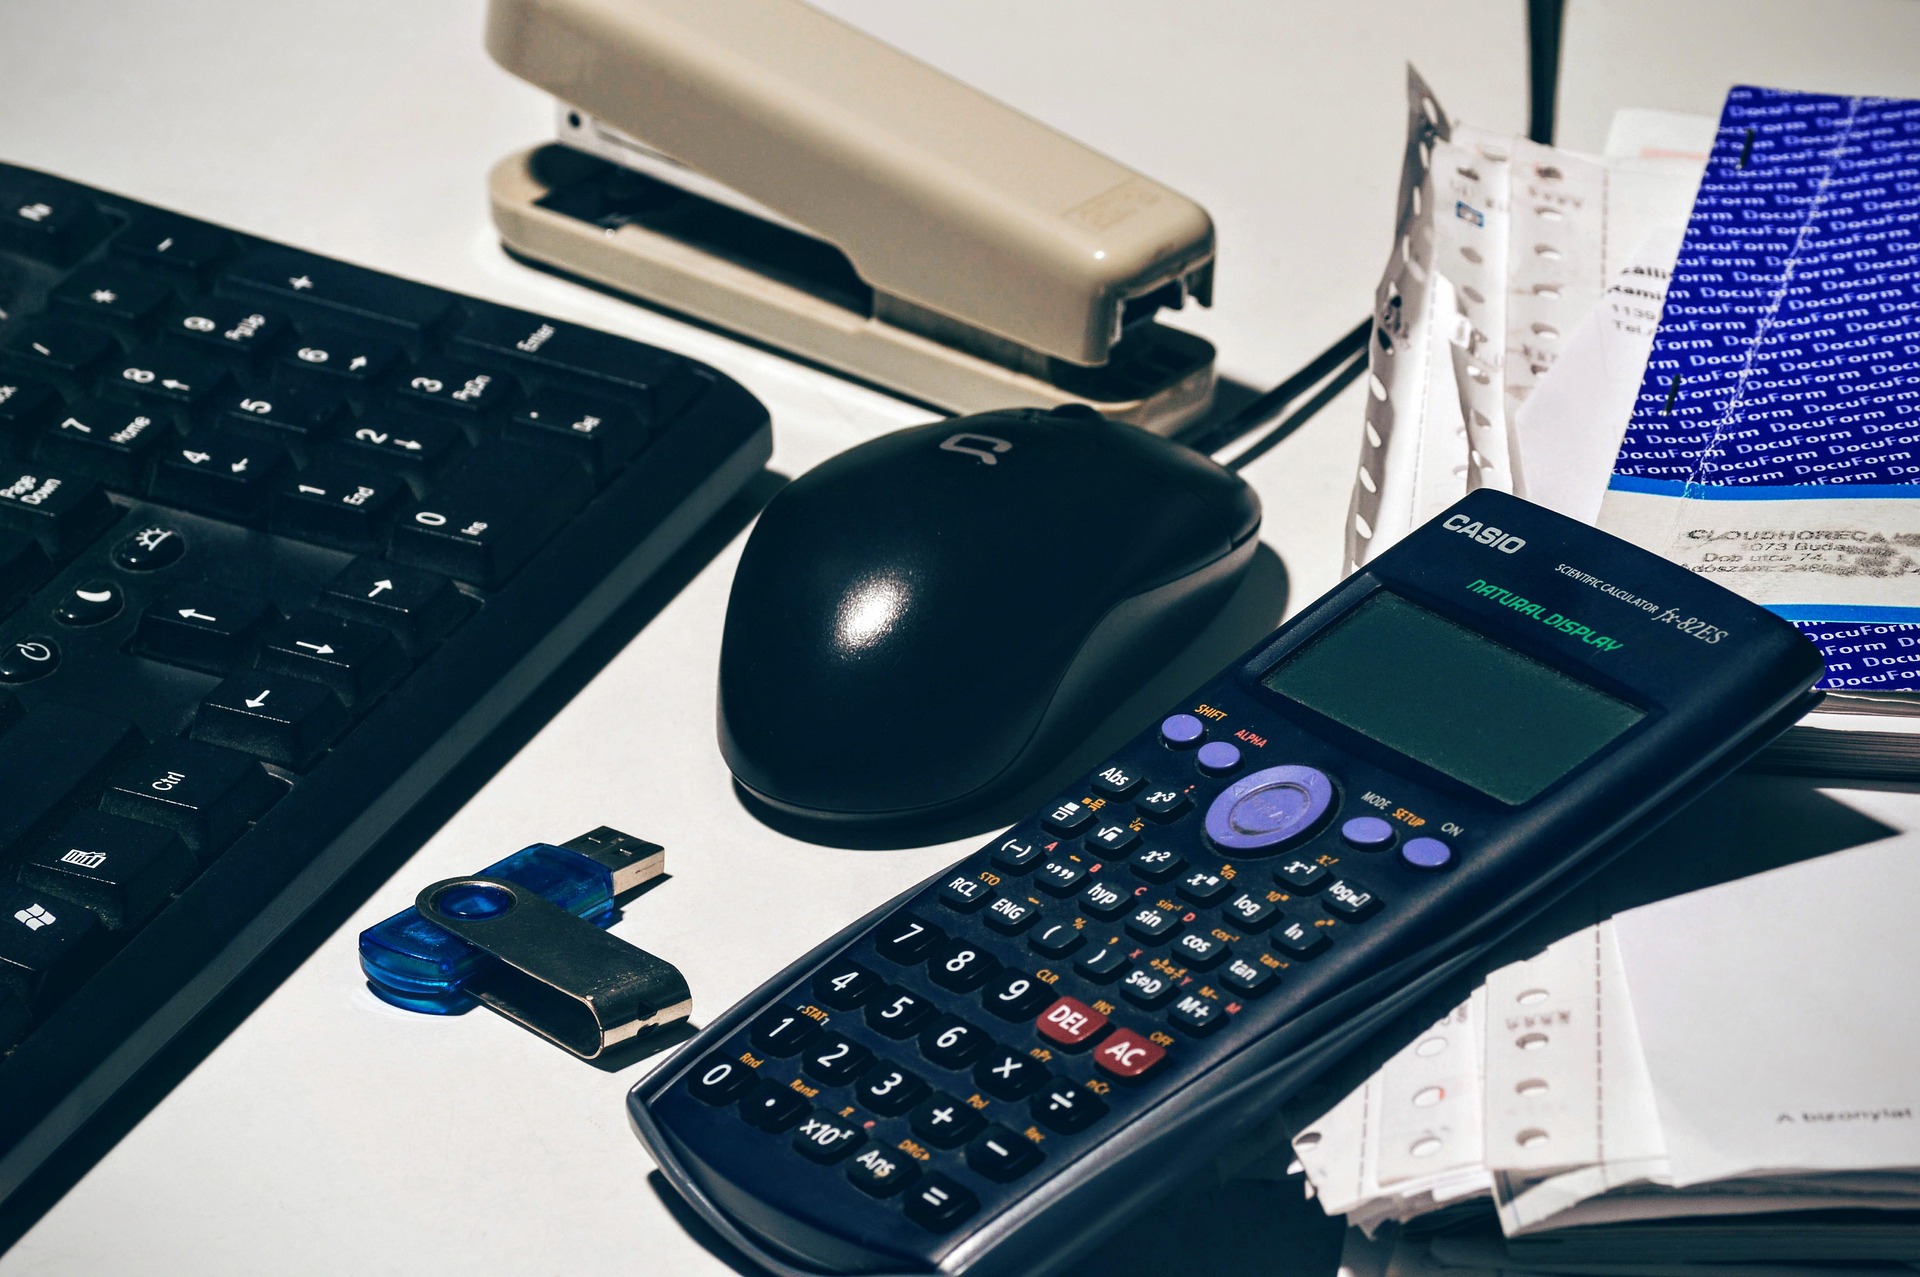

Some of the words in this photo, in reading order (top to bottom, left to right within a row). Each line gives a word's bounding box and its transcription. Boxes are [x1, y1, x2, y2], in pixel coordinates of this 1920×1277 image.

[1742, 206, 1854, 221] DocuForm
[1710, 224, 1821, 236] DocuForm
[1799, 229, 1911, 250] DocuForm
[1765, 248, 1878, 267] DocuForm
[1733, 267, 1845, 284] DocuForm
[1667, 302, 1779, 316] DocuForm
[1788, 288, 1903, 311] DocuForm
[1700, 286, 1812, 299] DocuForm
[1756, 308, 1870, 331] DocuForm
[1723, 328, 1836, 346] DocuForm
[298, 347, 329, 363] 6
[1690, 348, 1802, 366] DocuForm
[1779, 350, 1895, 372] DocuForm
[123, 367, 155, 383] 8
[411, 377, 443, 392] 3
[1745, 370, 1860, 391] DocuForm
[240, 398, 272, 414] 5
[1679, 409, 1794, 430] DocuForm
[1803, 390, 1920, 414] DocuForm
[1713, 390, 1827, 411] DocuForm
[61, 416, 92, 433] 7
[1646, 428, 1760, 445] DocuForm
[1769, 410, 1886, 433] DocuForm
[355, 428, 388, 444] 2
[1736, 431, 1852, 454] DocuForm
[182, 450, 211, 464] 4
[1703, 450, 1819, 473] DocuForm
[1794, 451, 1911, 475] DocuForm
[20, 478, 62, 505] Down
[298, 485, 326, 495] 1
[342, 485, 375, 506] End
[415, 511, 447, 526] 0
[461, 521, 488, 536] Ins
[1442, 514, 1527, 554] CASIO
[1555, 563, 1602, 589] SCIENTIFIC
[1600, 583, 1659, 614] CALCULATOR
[1652, 607, 1729, 644] fx-82ES
[1466, 579, 1549, 621] NATURAL
[1544, 613, 1624, 652] DISPLAY
[1195, 704, 1228, 721] SHIFT
[1234, 729, 1268, 749] ALPHA
[152, 771, 185, 791] Ctrl
[1099, 768, 1129, 786] Abs
[1361, 791, 1392, 810] MODE
[1392, 808, 1426, 828] SETUP
[1441, 822, 1464, 837] ON
[1044, 841, 1058, 851] A
[1089, 863, 1102, 873] B
[949, 877, 978, 897] RCL
[979, 872, 1000, 886] STO
[1087, 883, 1117, 904] hyp
[1134, 887, 1148, 896] C
[991, 898, 1025, 920] ENG
[1233, 894, 1261, 916] log
[1135, 910, 1162, 928] sin
[893, 923, 924, 943] 7
[1284, 923, 1304, 940] ln
[1182, 934, 1211, 953] cos
[946, 950, 976, 972] 8
[1229, 959, 1258, 981] tan
[830, 971, 859, 991] 4
[1036, 969, 1059, 984] CLR
[999, 979, 1030, 1001] 9
[881, 996, 914, 1018] 5
[1091, 1000, 1115, 1015] INS
[1177, 996, 1210, 1018] M+
[769, 1017, 795, 1037] 1
[1047, 1005, 1089, 1035] DEL
[936, 1026, 968, 1048] 6
[739, 1052, 764, 1069] Rnd
[817, 1043, 849, 1067] 2
[1104, 1041, 1147, 1067] AC
[702, 1063, 732, 1085] 0
[870, 1072, 903, 1095] 3
[856, 1149, 896, 1178] Ans
